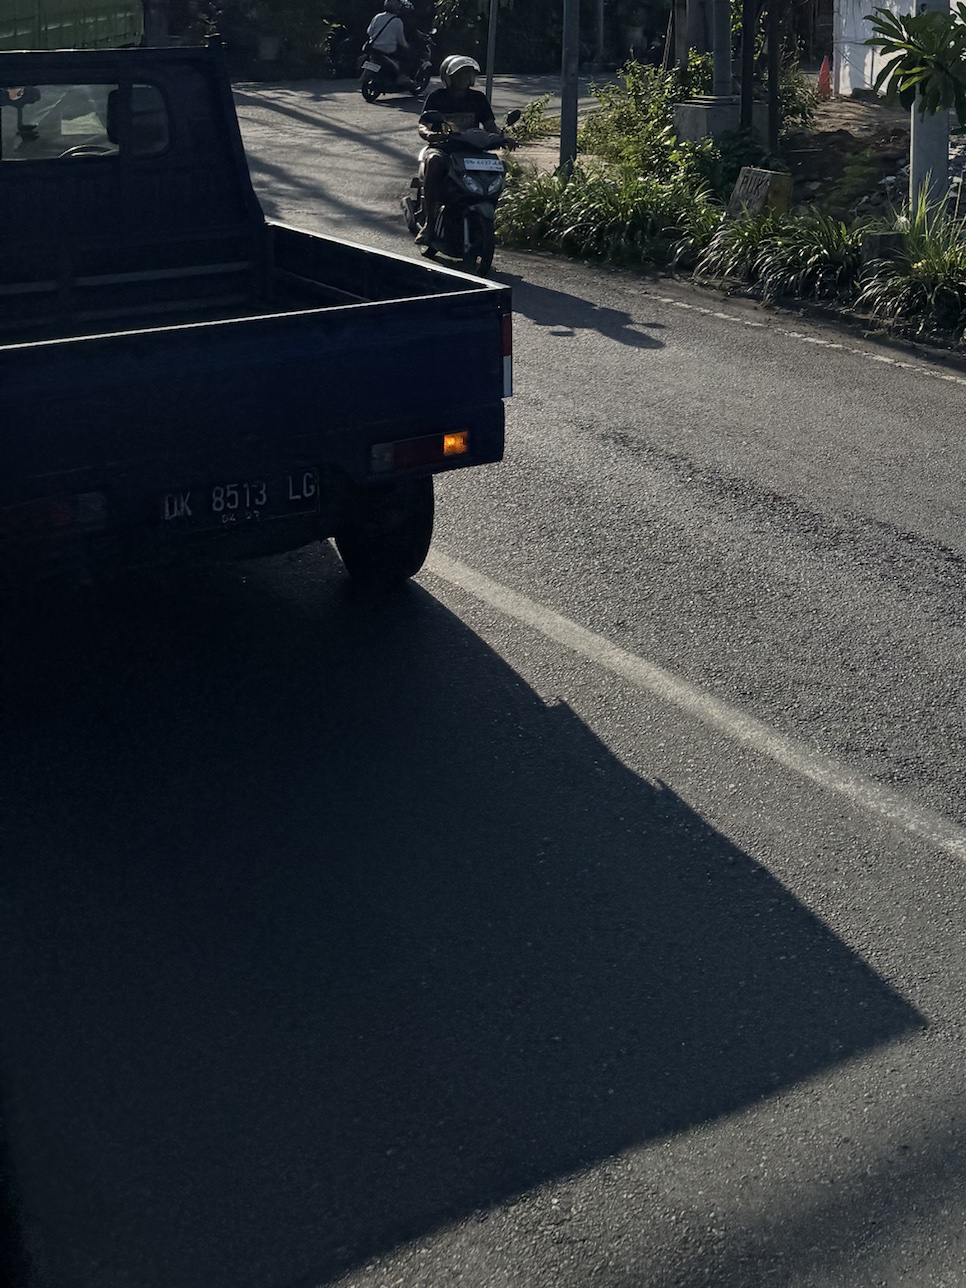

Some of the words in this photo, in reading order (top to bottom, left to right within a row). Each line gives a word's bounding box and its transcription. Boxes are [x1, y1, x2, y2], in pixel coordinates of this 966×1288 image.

[164, 491, 192, 520] DK
[212, 480, 267, 512] 8513
[288, 472, 316, 500] LG
